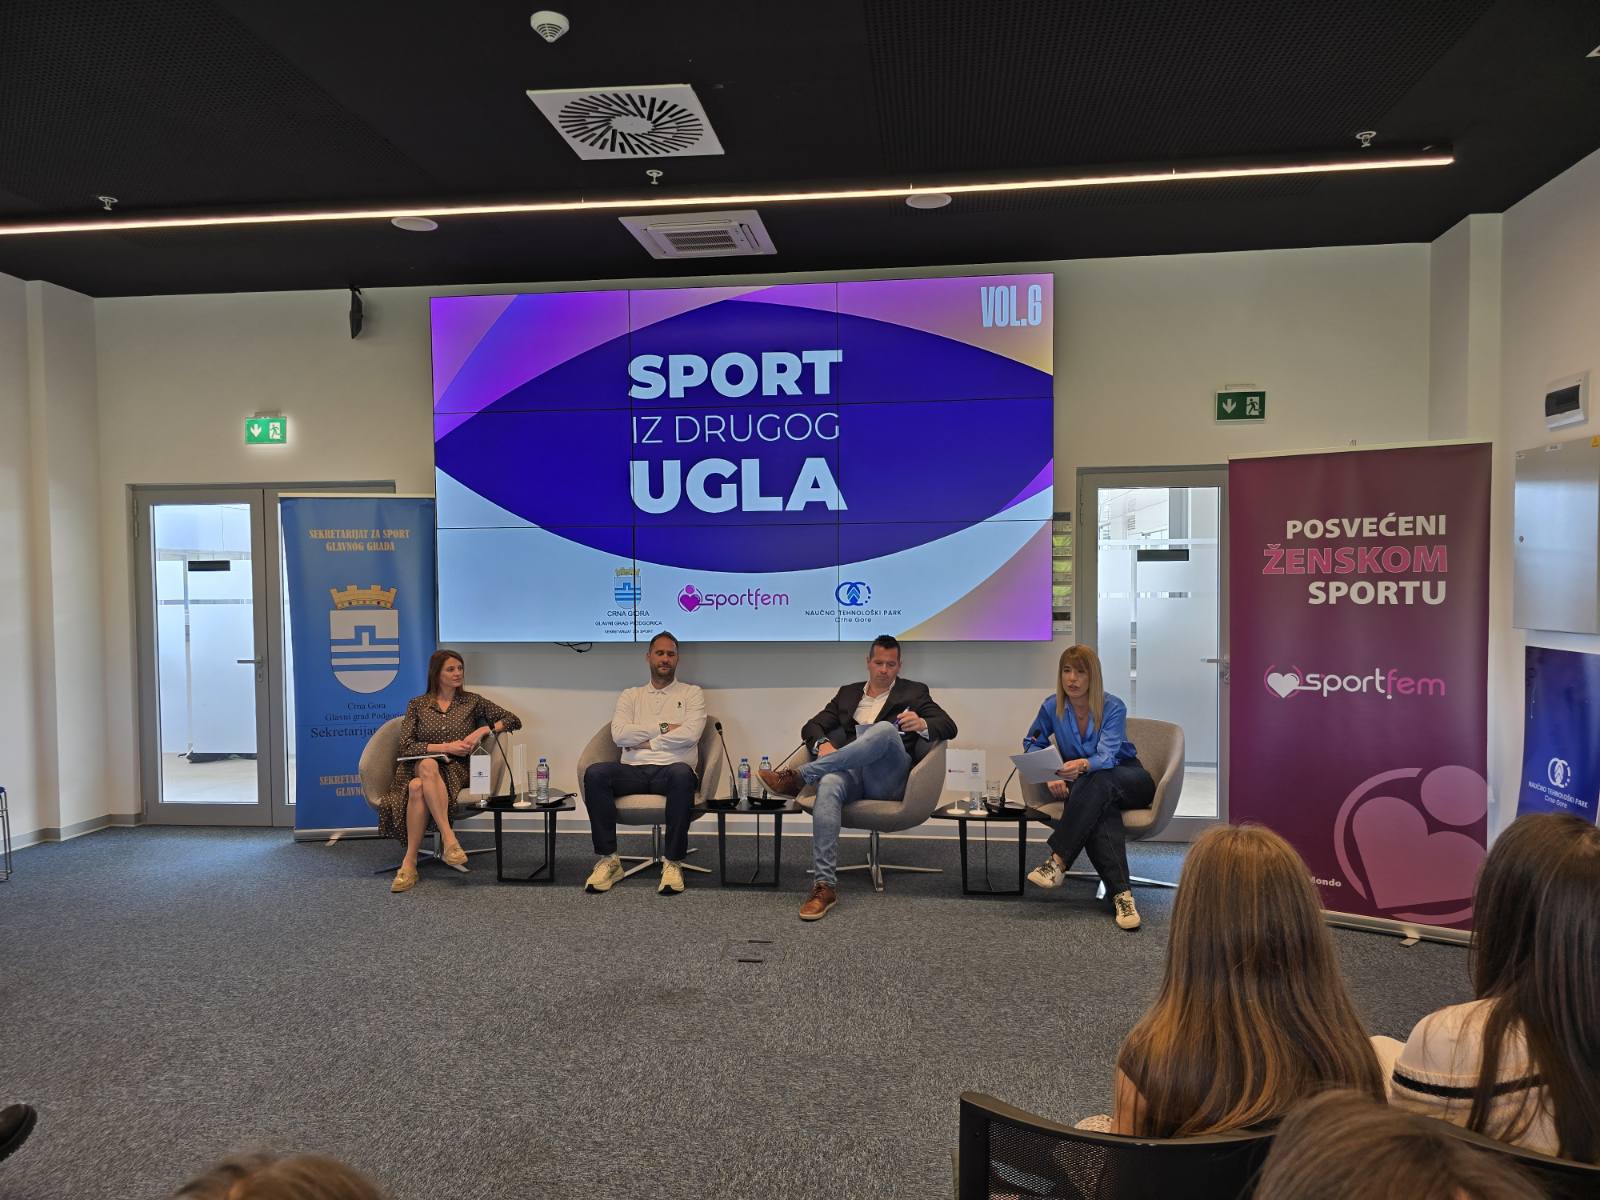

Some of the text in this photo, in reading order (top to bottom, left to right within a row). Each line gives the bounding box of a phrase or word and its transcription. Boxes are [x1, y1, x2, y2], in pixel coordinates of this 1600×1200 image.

[980, 284, 1042, 328] VOL.6
[628, 349, 843, 400] SPORT
[632, 412, 840, 444] IZ DRUGOG
[629, 457, 848, 514] UGLA
[370, 529, 381, 539] ZA
[383, 529, 410, 539] SPORT
[1286, 512, 1447, 540] POSVEĆENI
[325, 541, 395, 552] GLAVNOG GRADA
[1262, 543, 1448, 575] ŽENSKOM
[704, 587, 790, 611] sportfem
[1308, 580, 1447, 605] SPORTU
[805, 607, 902, 616] NAUČNO TEHNOLOŠKI PARK
[1305, 668, 1446, 700] sportfem
[347, 702, 386, 711] Crna Gora
